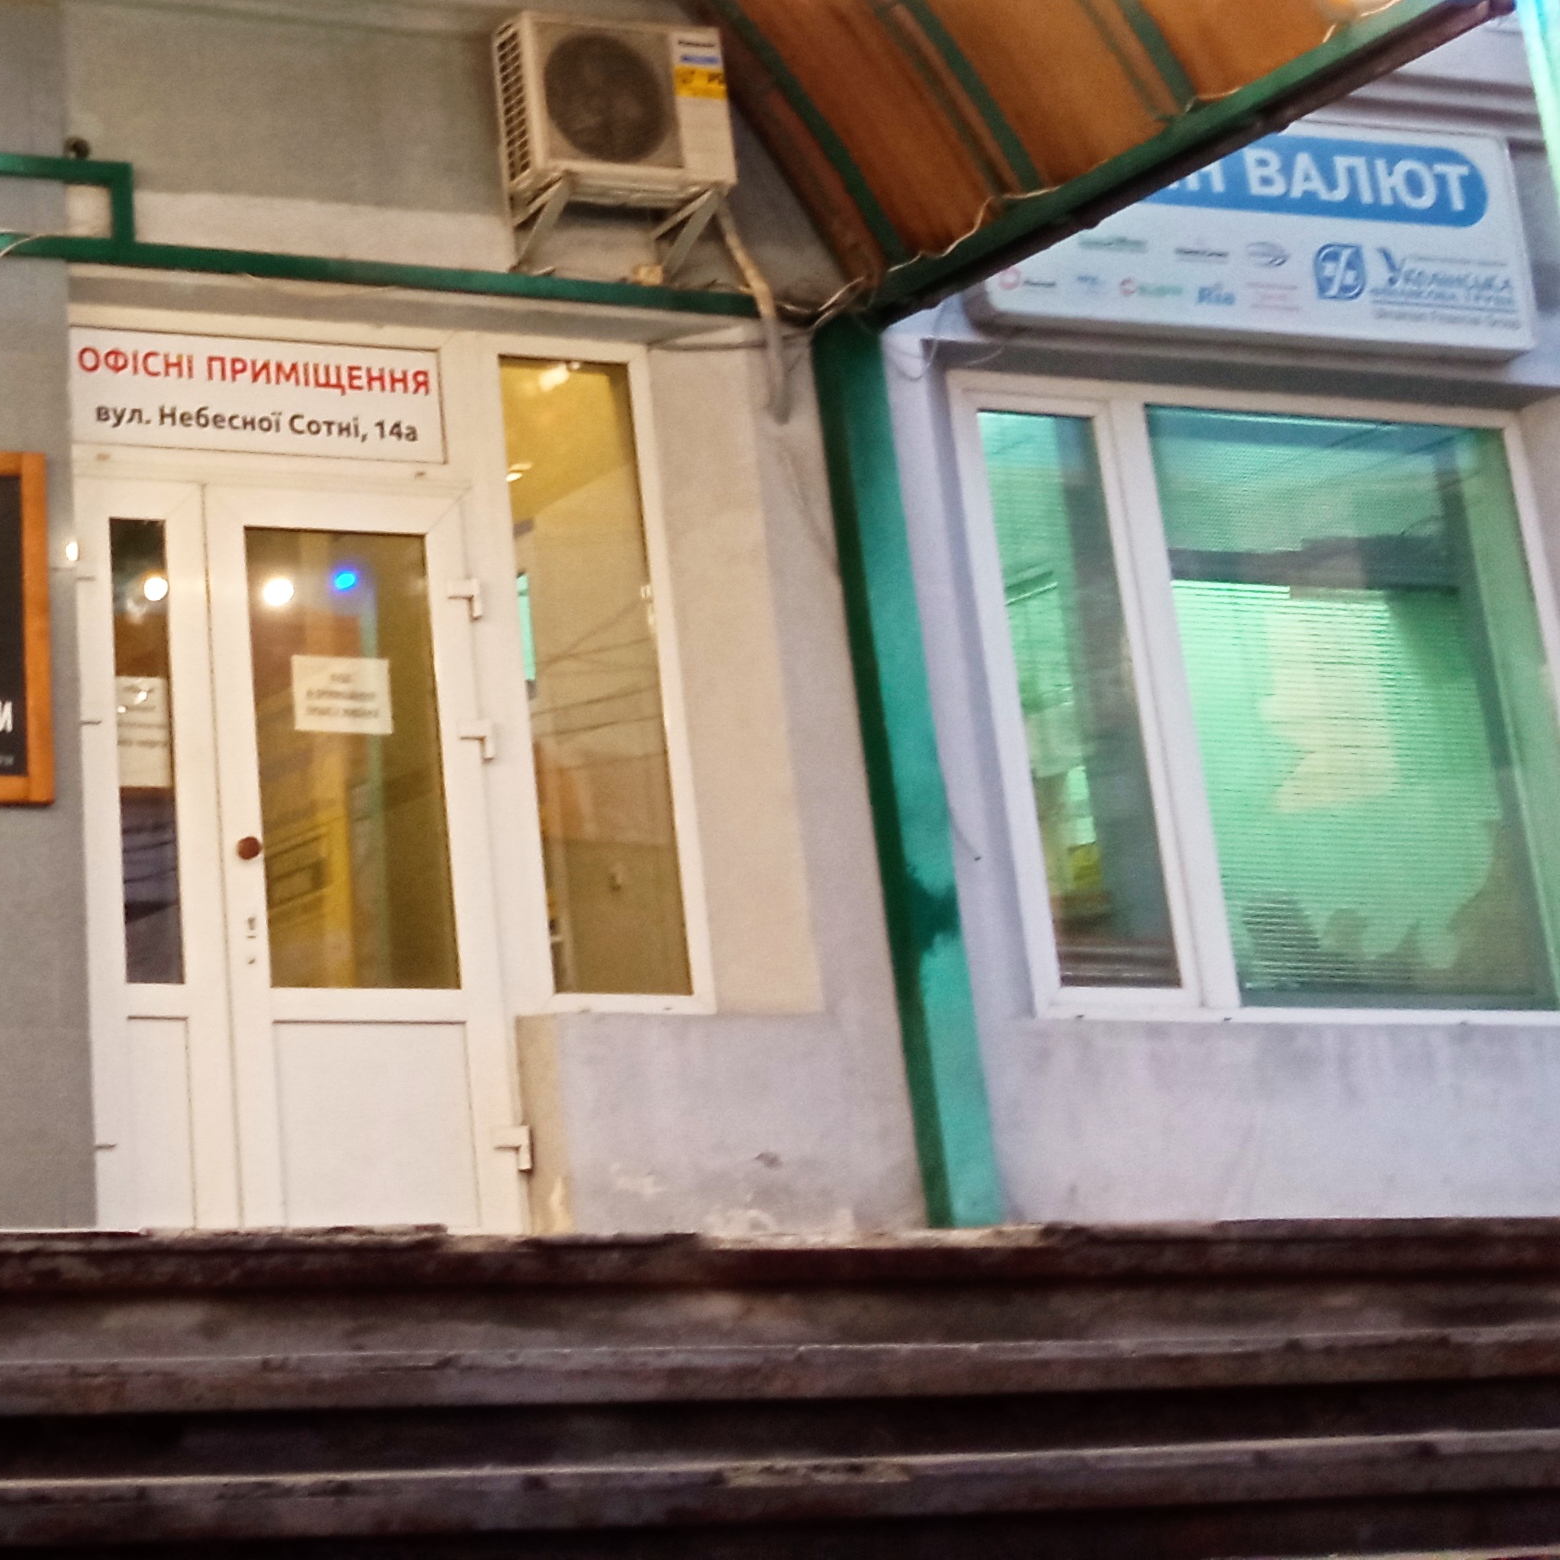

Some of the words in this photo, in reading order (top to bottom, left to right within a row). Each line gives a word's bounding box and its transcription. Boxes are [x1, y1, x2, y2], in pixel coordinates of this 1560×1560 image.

[1242, 146, 1470, 212] ВАЛЮТ
[77, 346, 195, 380] ОФІСНІ
[206, 354, 431, 397] ПРИМІЩЕННЯ
[95, 405, 151, 429] вул.
[158, 404, 283, 434] Небесної
[288, 413, 369, 442] Сотні,
